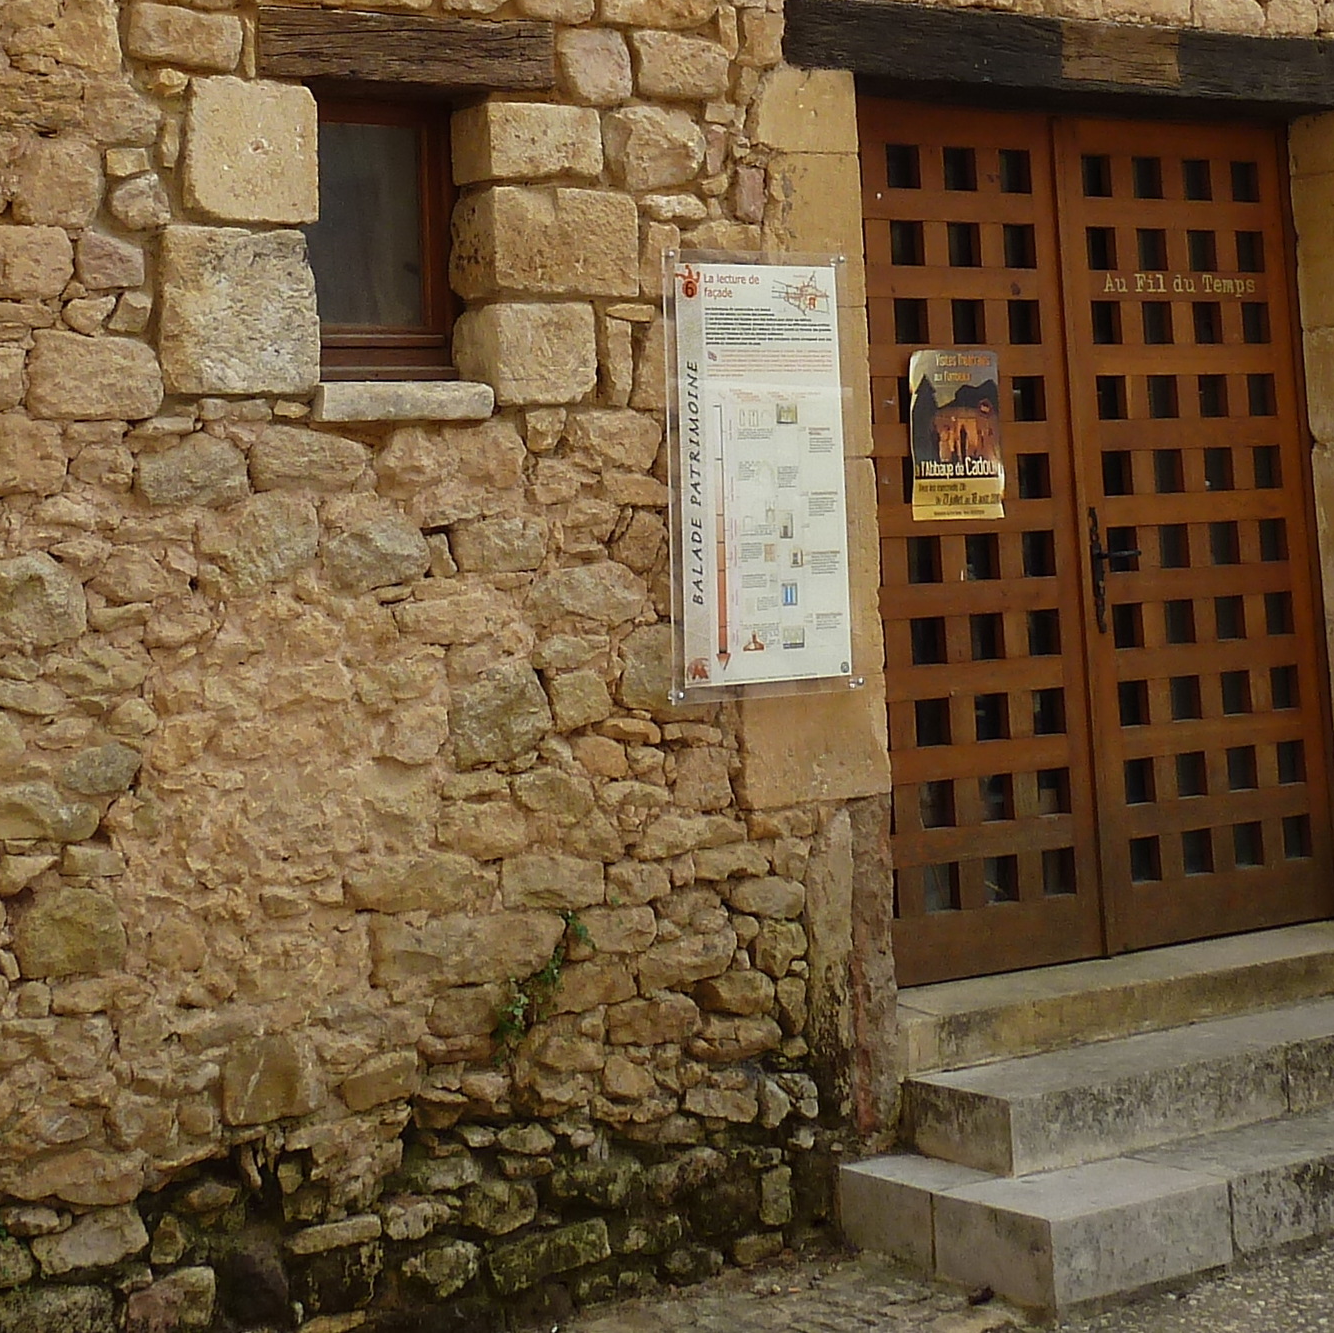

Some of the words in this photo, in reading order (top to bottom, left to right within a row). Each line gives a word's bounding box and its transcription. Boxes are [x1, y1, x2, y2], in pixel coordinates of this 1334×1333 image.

[704, 274, 714, 284] La
[717, 273, 746, 284] lecture
[749, 274, 760, 284] de
[1103, 273, 1128, 292] Au
[1134, 273, 1167, 292] Fil
[1173, 274, 1196, 293] du
[1202, 274, 1255, 297] Temps
[704, 286, 733, 300] façade
[687, 360, 701, 507] PATRIMOINE
[955, 462, 965, 476] de
[691, 517, 704, 606] BALADE
